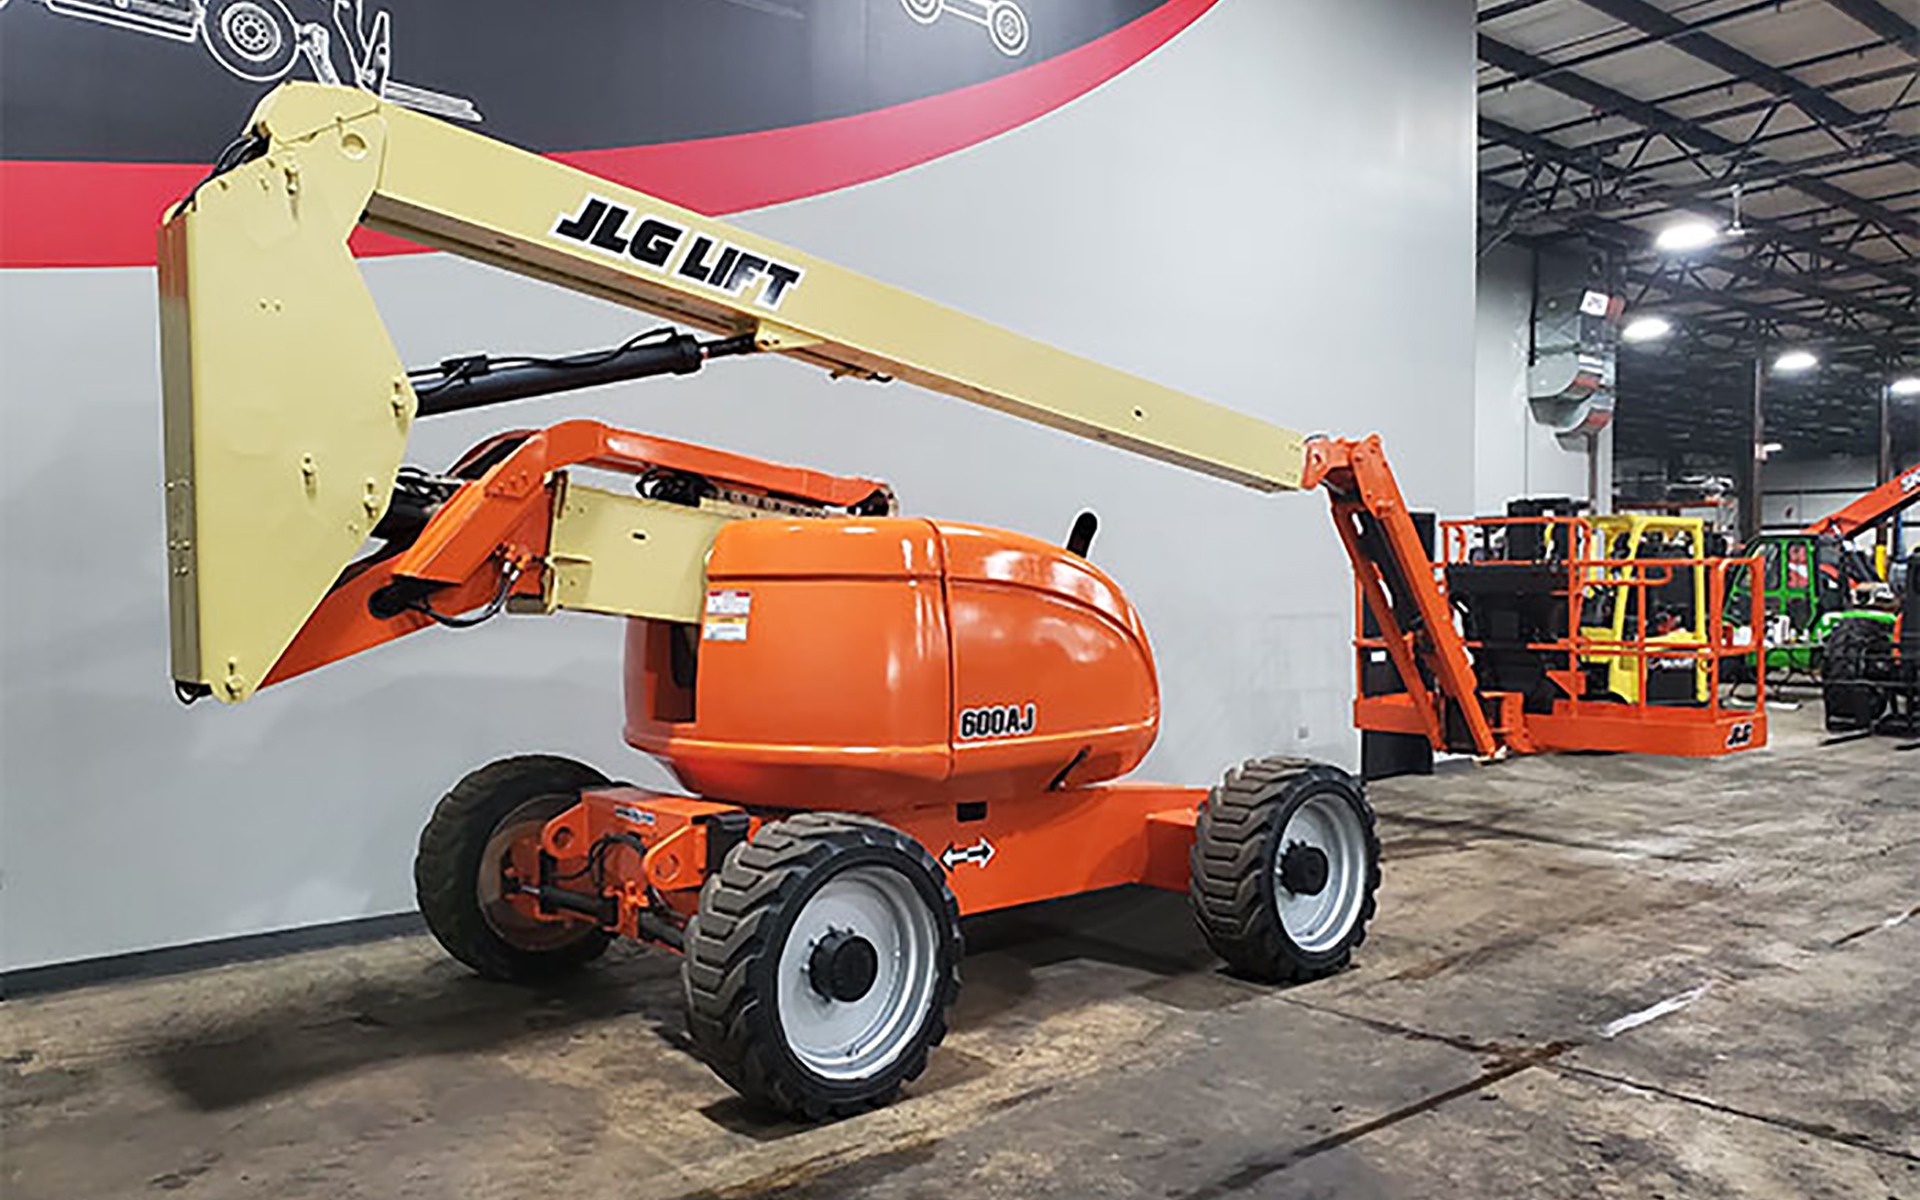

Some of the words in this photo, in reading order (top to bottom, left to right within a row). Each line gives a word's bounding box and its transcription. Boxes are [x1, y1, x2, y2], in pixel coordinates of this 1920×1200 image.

[554, 196, 685, 269] JLG
[677, 235, 802, 306] LIFT
[960, 705, 1035, 738] 600AJ
